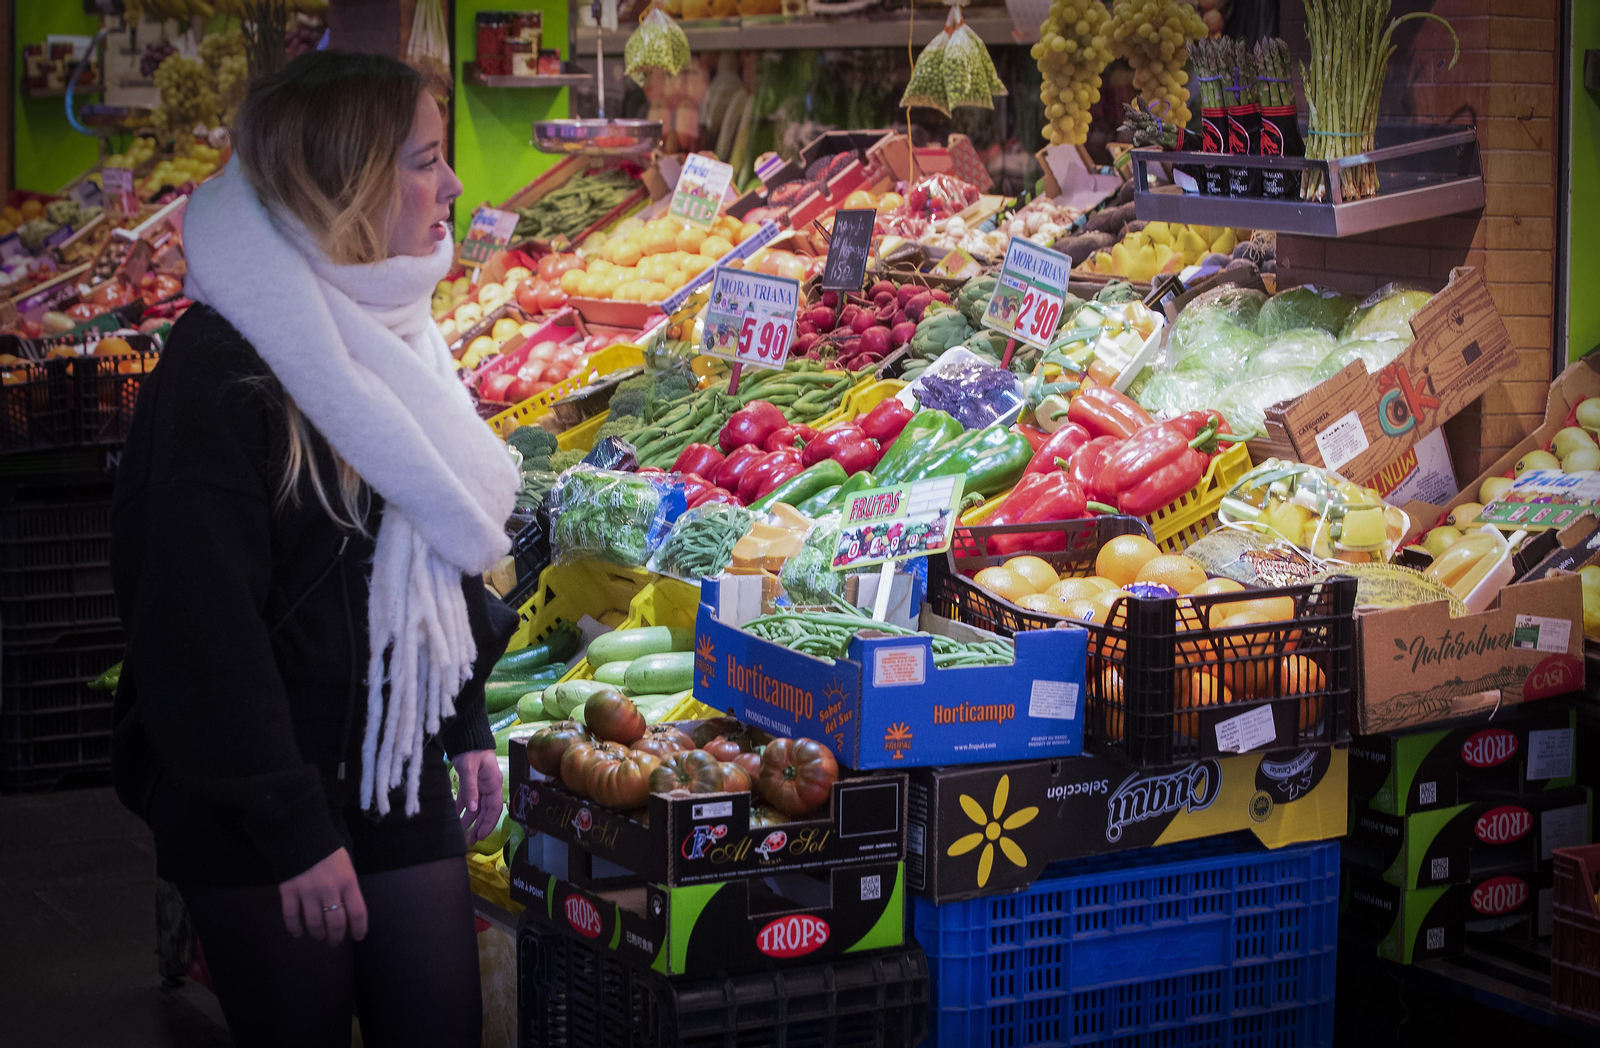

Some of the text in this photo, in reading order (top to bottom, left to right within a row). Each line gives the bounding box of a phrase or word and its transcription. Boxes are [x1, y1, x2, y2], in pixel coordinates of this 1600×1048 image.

[1011, 249, 1037, 271] MORA
[1038, 260, 1067, 284] TRIANA
[720, 278, 792, 305] MORA TRIANA
[1513, 470, 1584, 488] Frutas
[849, 489, 903, 523] FRUTAS
[727, 653, 814, 724] Horticampo
[1532, 669, 1564, 690] CASI
[745, 708, 792, 737] PRODUCTO NATURAL
[818, 701, 842, 722] Sabor
[825, 710, 853, 735] del Sur
[933, 700, 1016, 725] Horticampo
[884, 741, 912, 751] FRUPAL
[954, 741, 997, 751] www.frupal.com
[1349, 747, 1364, 758] POIN
[1463, 734, 1516, 764] TROPS
[1047, 779, 1109, 800] Selección
[1106, 758, 1223, 844] Cuqui
[1476, 811, 1530, 841] TROPS
[789, 826, 831, 856] Sol
[513, 877, 525, 890] MÛR
[529, 884, 544, 900] POINT
[1353, 890, 1375, 905] PUNTO
[1472, 883, 1526, 912] TROPS
[565, 897, 601, 935] TROPS
[1383, 900, 1392, 911] EN
[760, 916, 828, 951] TROPS
